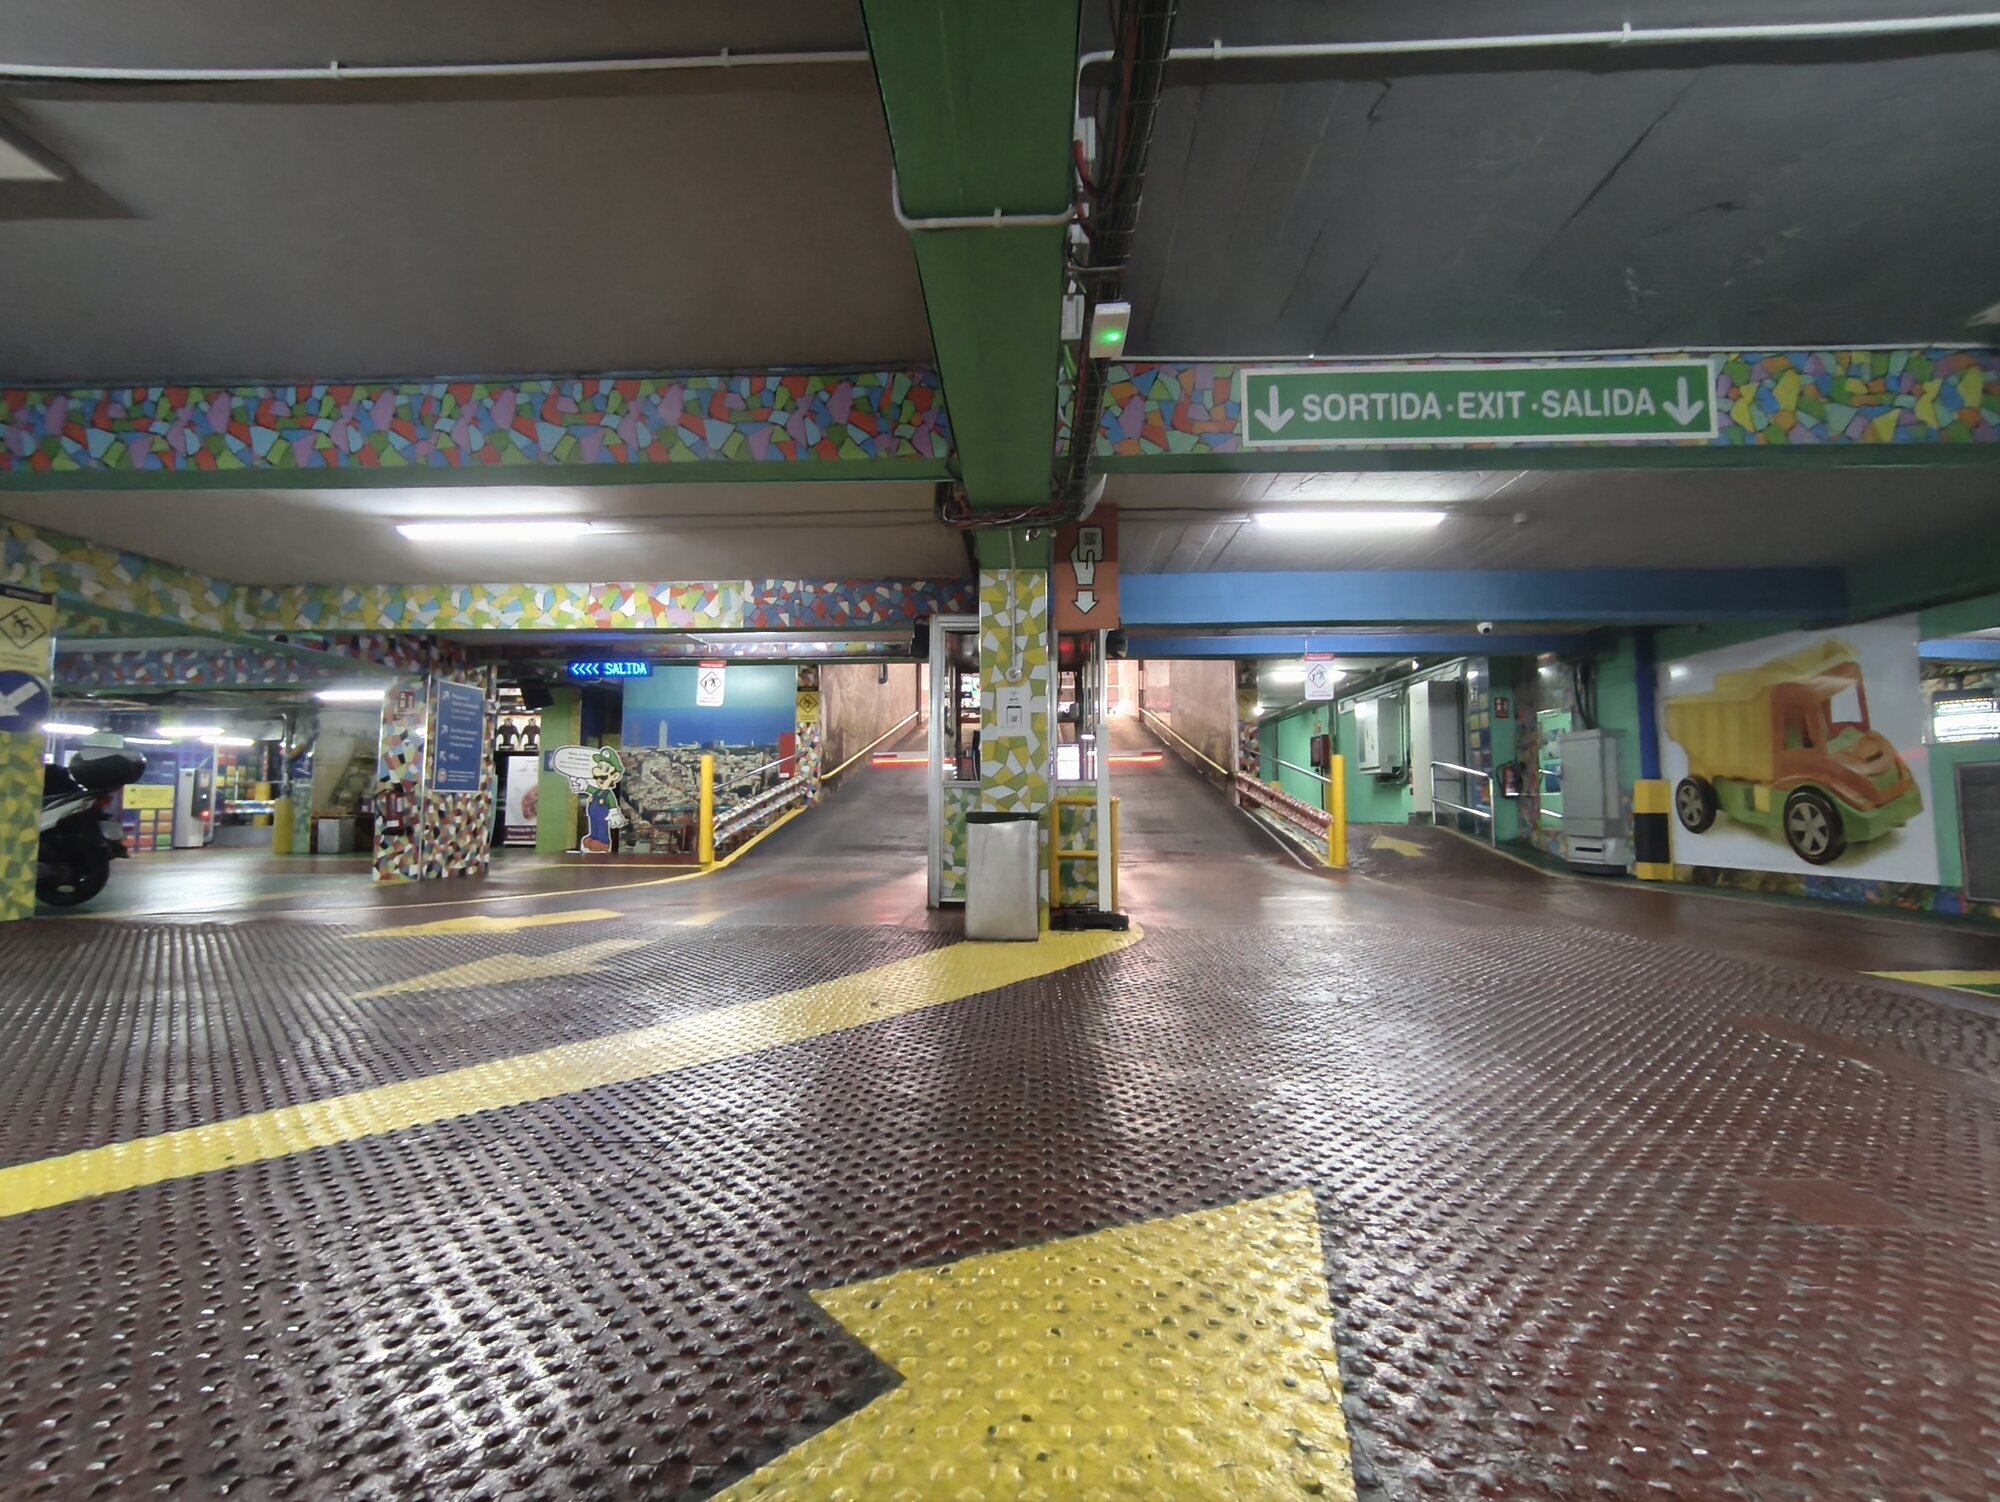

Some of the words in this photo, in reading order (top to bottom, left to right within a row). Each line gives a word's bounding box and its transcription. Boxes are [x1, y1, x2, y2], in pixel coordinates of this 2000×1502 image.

[1302, 392, 1441, 422] SORTIDA
[1457, 391, 1526, 419] EXIT
[1541, 387, 1656, 419] SALIDA
[604, 662, 648, 676] SALIDA
